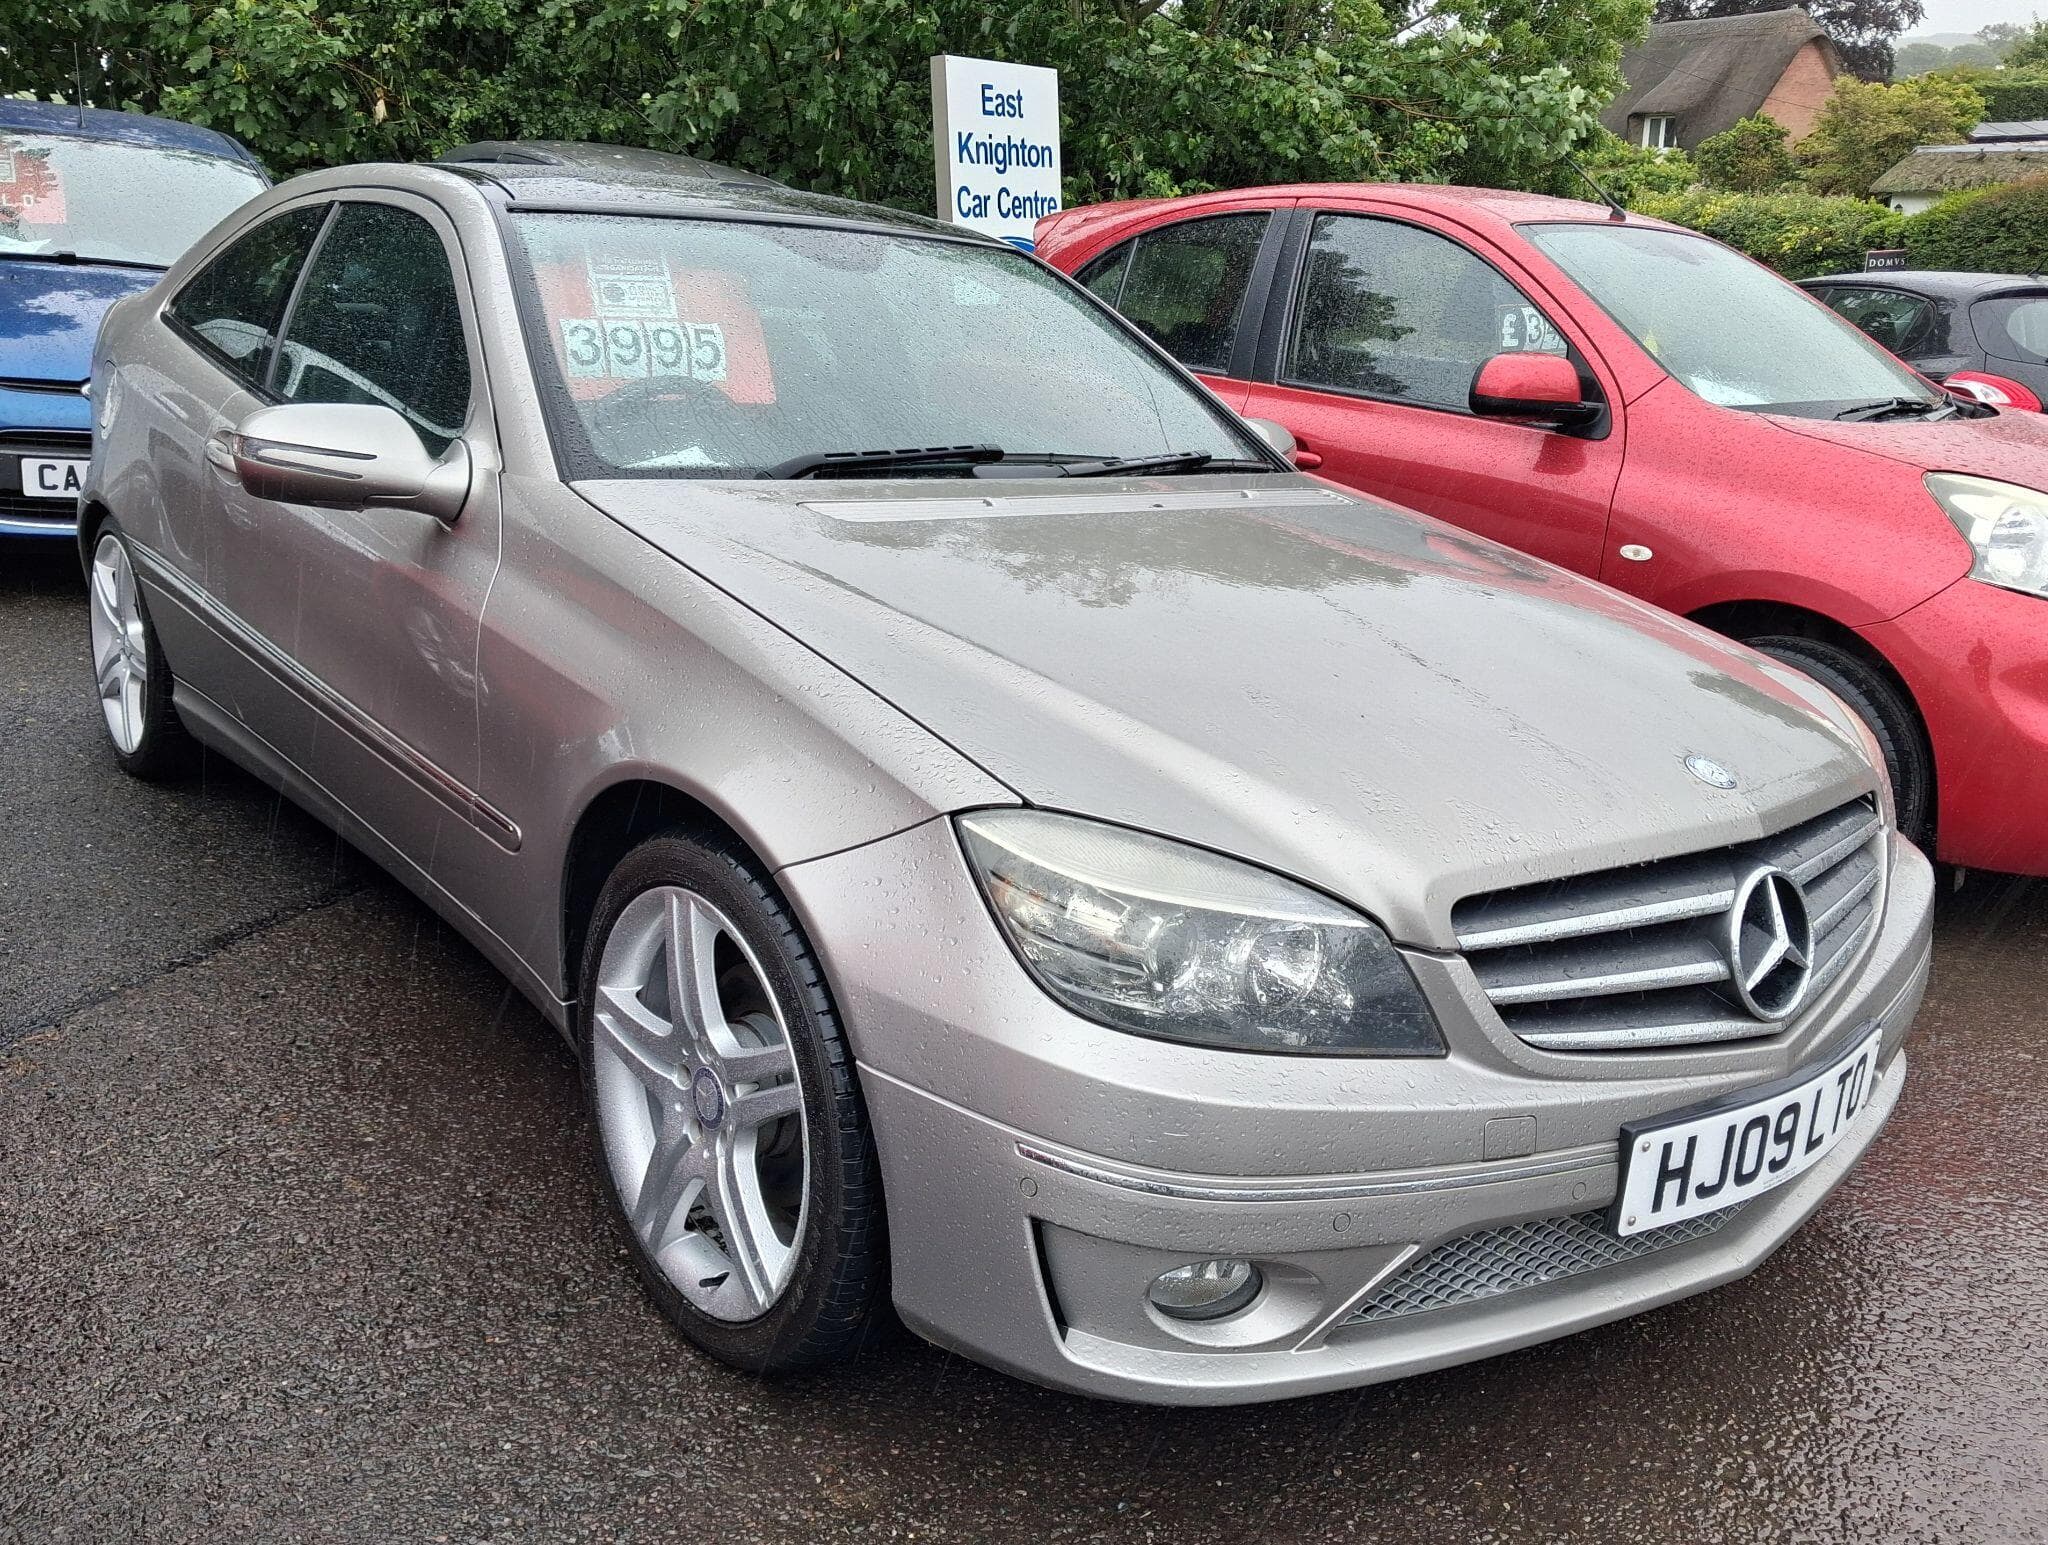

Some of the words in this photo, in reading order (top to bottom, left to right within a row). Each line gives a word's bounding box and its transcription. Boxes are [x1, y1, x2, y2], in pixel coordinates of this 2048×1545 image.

[981, 84, 1024, 118] East
[957, 131, 1053, 175] Knighton
[957, 185, 991, 218] Car
[997, 186, 1058, 219] Centre
[569, 325, 721, 370] 3995
[38, 463, 90, 491] CA
[1651, 1101, 1801, 1213] HJ09
